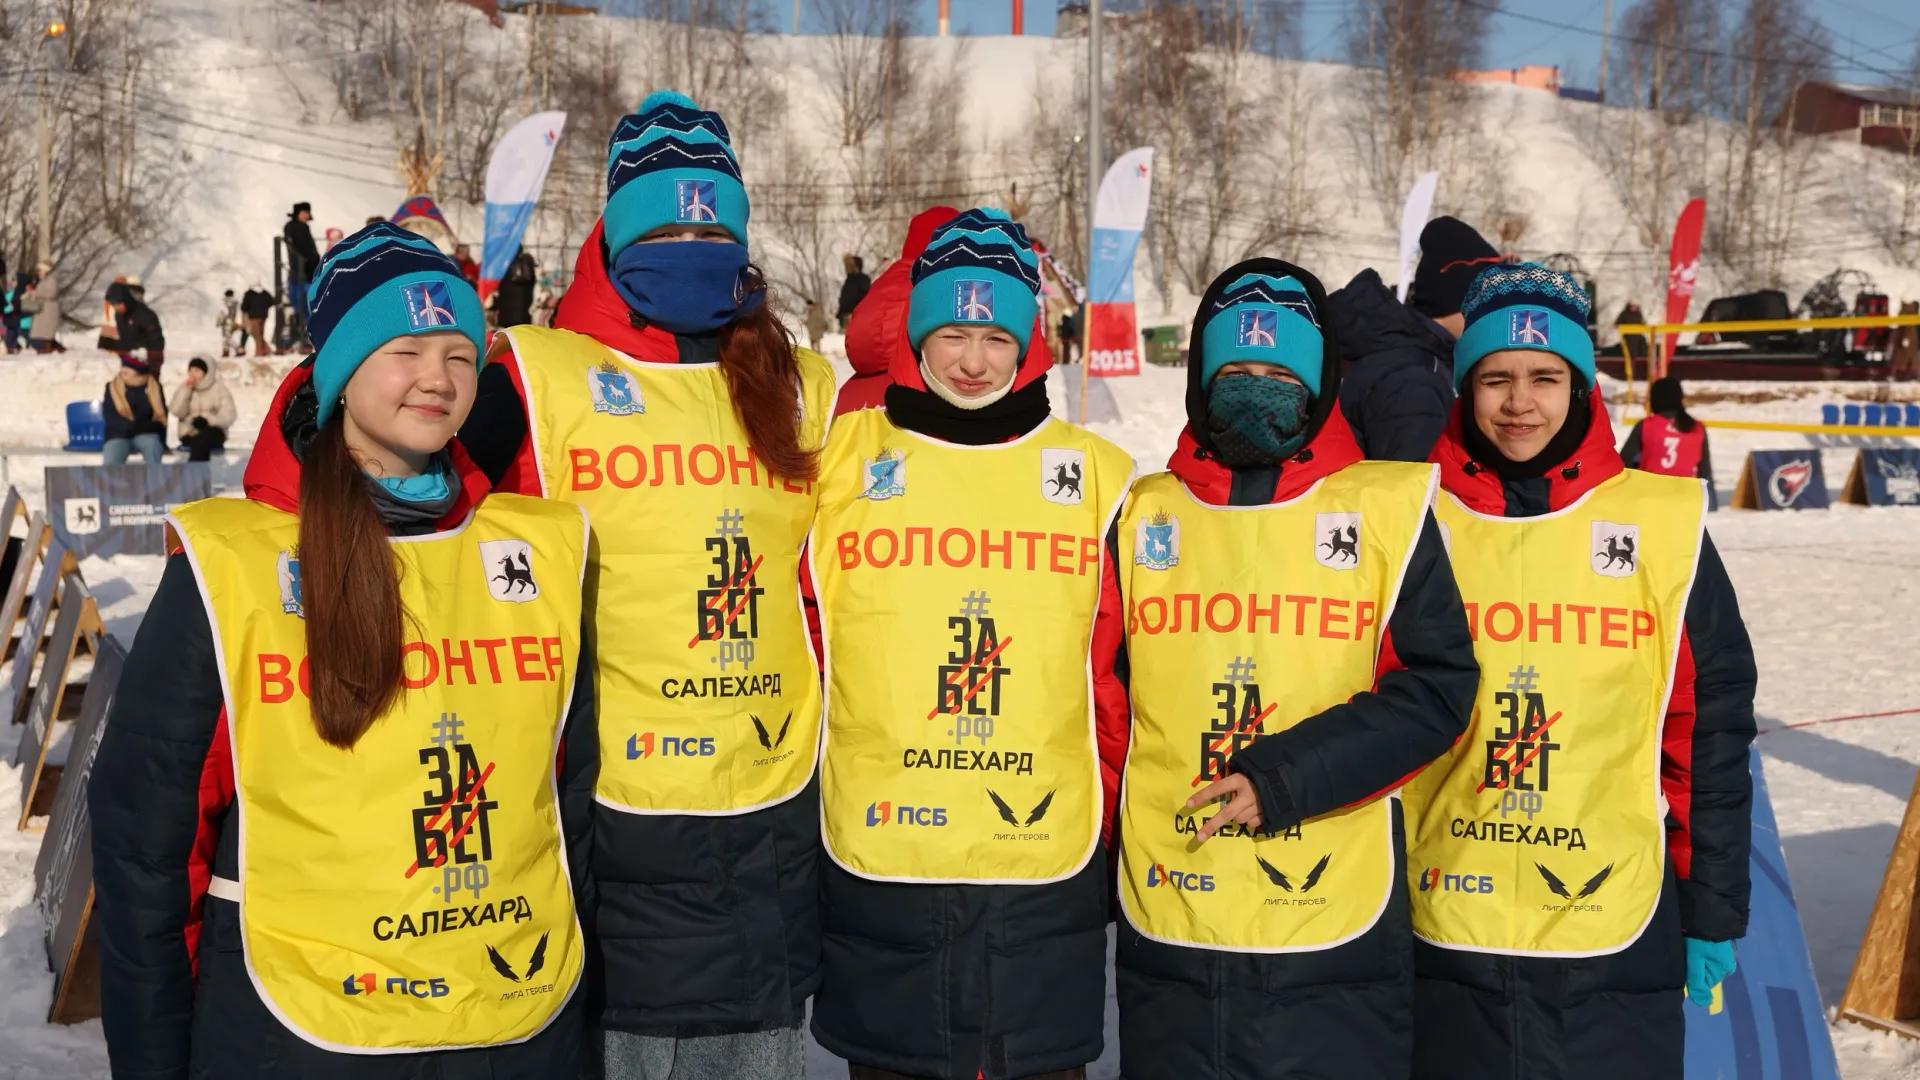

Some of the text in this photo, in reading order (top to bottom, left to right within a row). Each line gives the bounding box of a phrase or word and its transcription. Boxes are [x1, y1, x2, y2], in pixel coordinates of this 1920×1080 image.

[569, 444, 817, 496] ВОЛОН
[1660, 436, 1681, 469] 3
[705, 536, 757, 589] ЗА
[837, 527, 1099, 576] ВОЛОНТЕР
[697, 588, 765, 641] БЕГ
[948, 616, 1001, 666] ЗА
[258, 637, 561, 703] ВОНТЕР
[661, 673, 781, 699] САЛЕХАРД
[937, 665, 1011, 716] БЕГ
[1211, 683, 1264, 733] ЗА
[1495, 692, 1550, 741] ЗА
[662, 736, 716, 757] ПСБ
[903, 748, 1033, 775] САЛЕХАРД
[1485, 740, 1560, 791] БЕГ
[419, 743, 487, 806] ЗА
[412, 801, 498, 868] БЕГ
[897, 806, 948, 826] ПСБ
[1451, 818, 1586, 851] САЛЕХАРД
[992, 833, 1050, 841] ЛИГА ГЕРОЕВ
[1169, 870, 1216, 892] ПСБ
[1444, 874, 1494, 894] ПСБ
[373, 895, 532, 941] САЛЕХАРД
[1263, 897, 1327, 907] ЛИГА ГЕРОЕВ
[1541, 904, 1603, 912] ЛИГА ГЕРОЕВ
[386, 977, 450, 999] ПСБ
[500, 984, 554, 1001] ЛИГА ГЕРОЕВ
